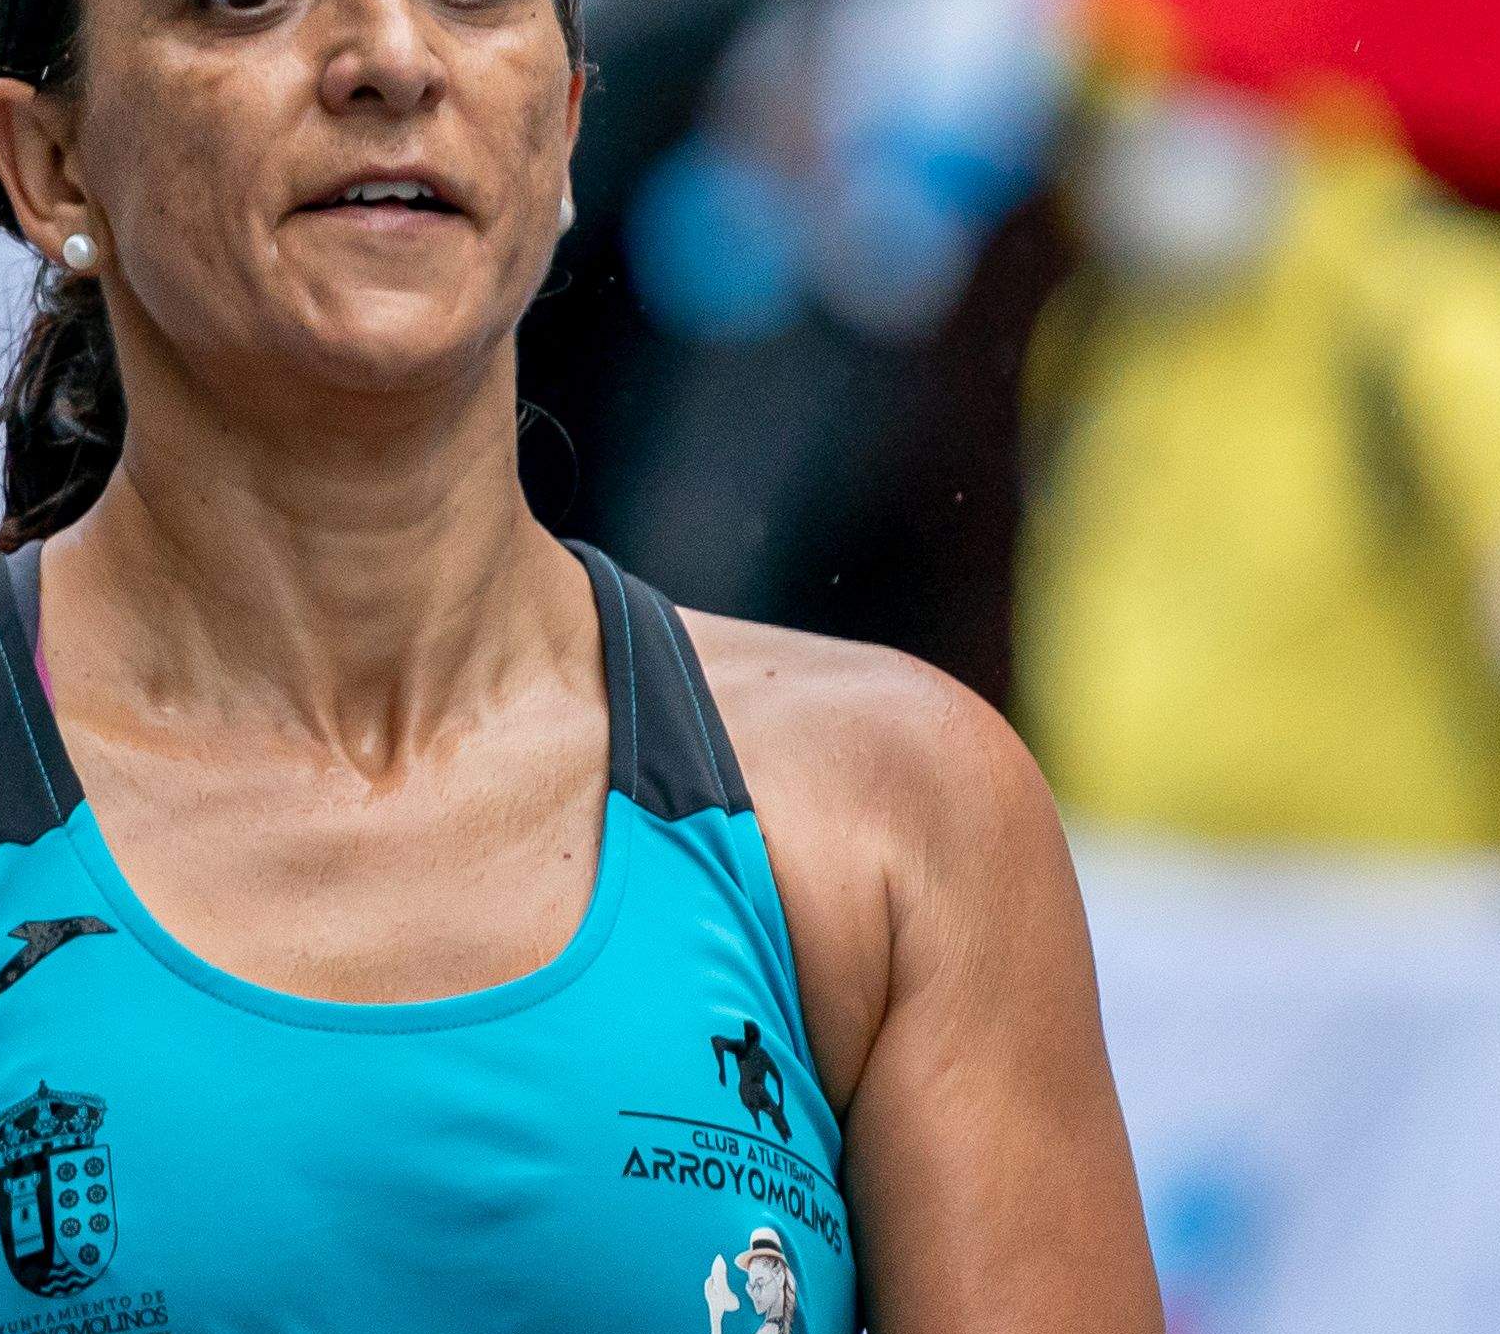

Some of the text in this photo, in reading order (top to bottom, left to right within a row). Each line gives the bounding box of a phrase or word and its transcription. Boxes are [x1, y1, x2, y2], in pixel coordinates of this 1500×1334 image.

[692, 1130, 816, 1192] CLUB ATLETISMO
[621, 1146, 844, 1256] ARROYOMOLINOS
[140, 1290, 167, 1306] DE
